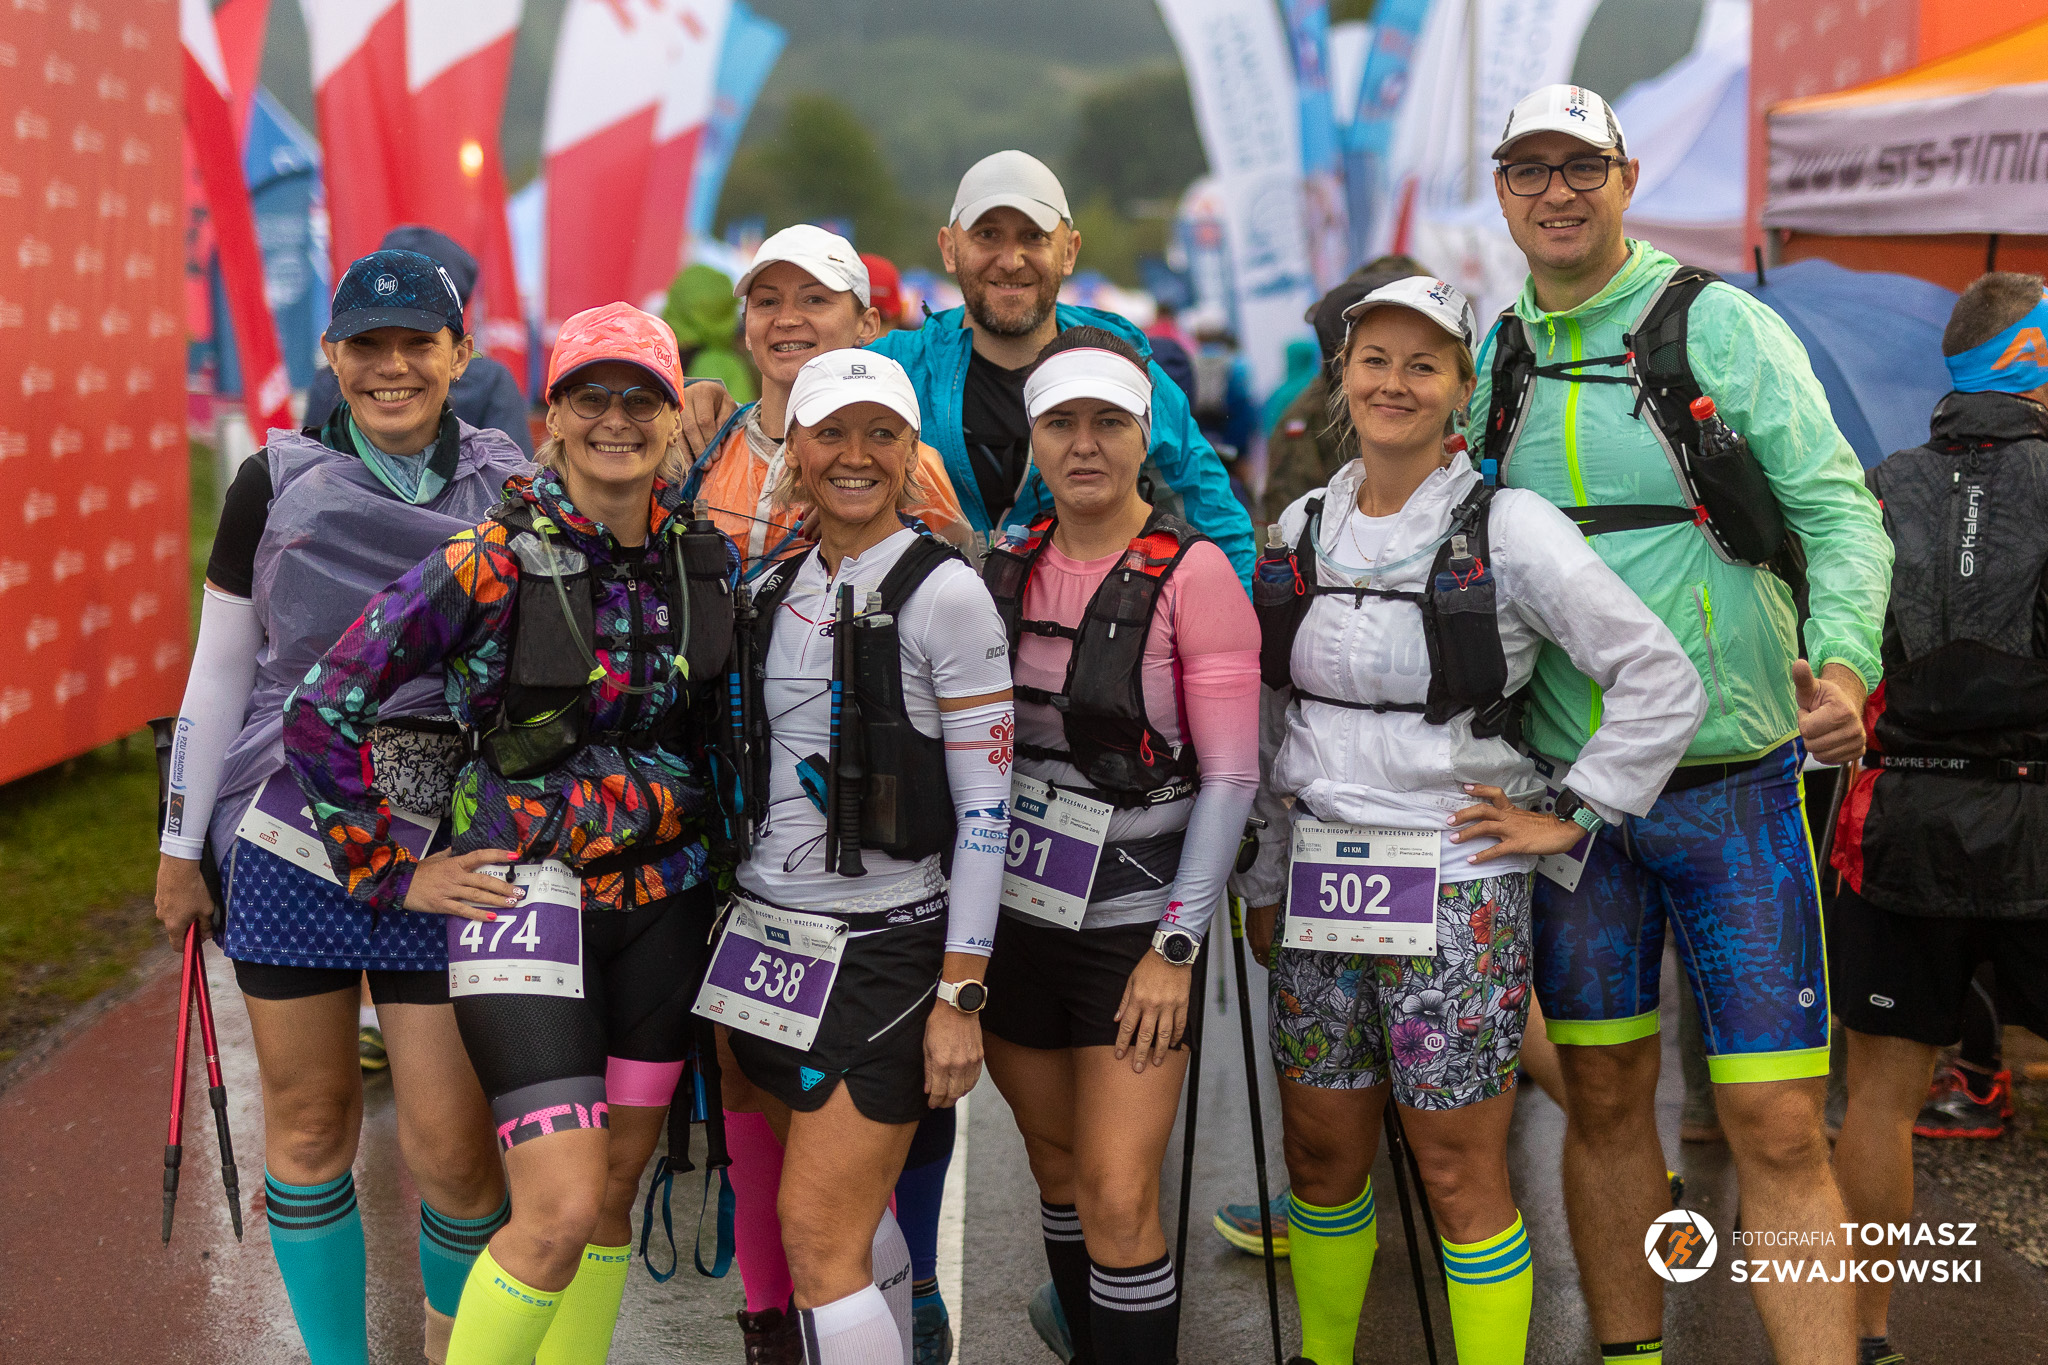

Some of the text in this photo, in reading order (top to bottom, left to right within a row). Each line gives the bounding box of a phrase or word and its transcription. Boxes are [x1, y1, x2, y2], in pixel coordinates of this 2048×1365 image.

[378, 278, 396, 292] Buff
[657, 346, 671, 365] Buff
[1961, 485, 1985, 548] Kalenji
[176, 751, 187, 782] CRACOVIA
[1351, 846, 1362, 854] KM
[1319, 872, 1391, 915] 502
[460, 910, 541, 953] 474
[744, 952, 805, 1003] 538
